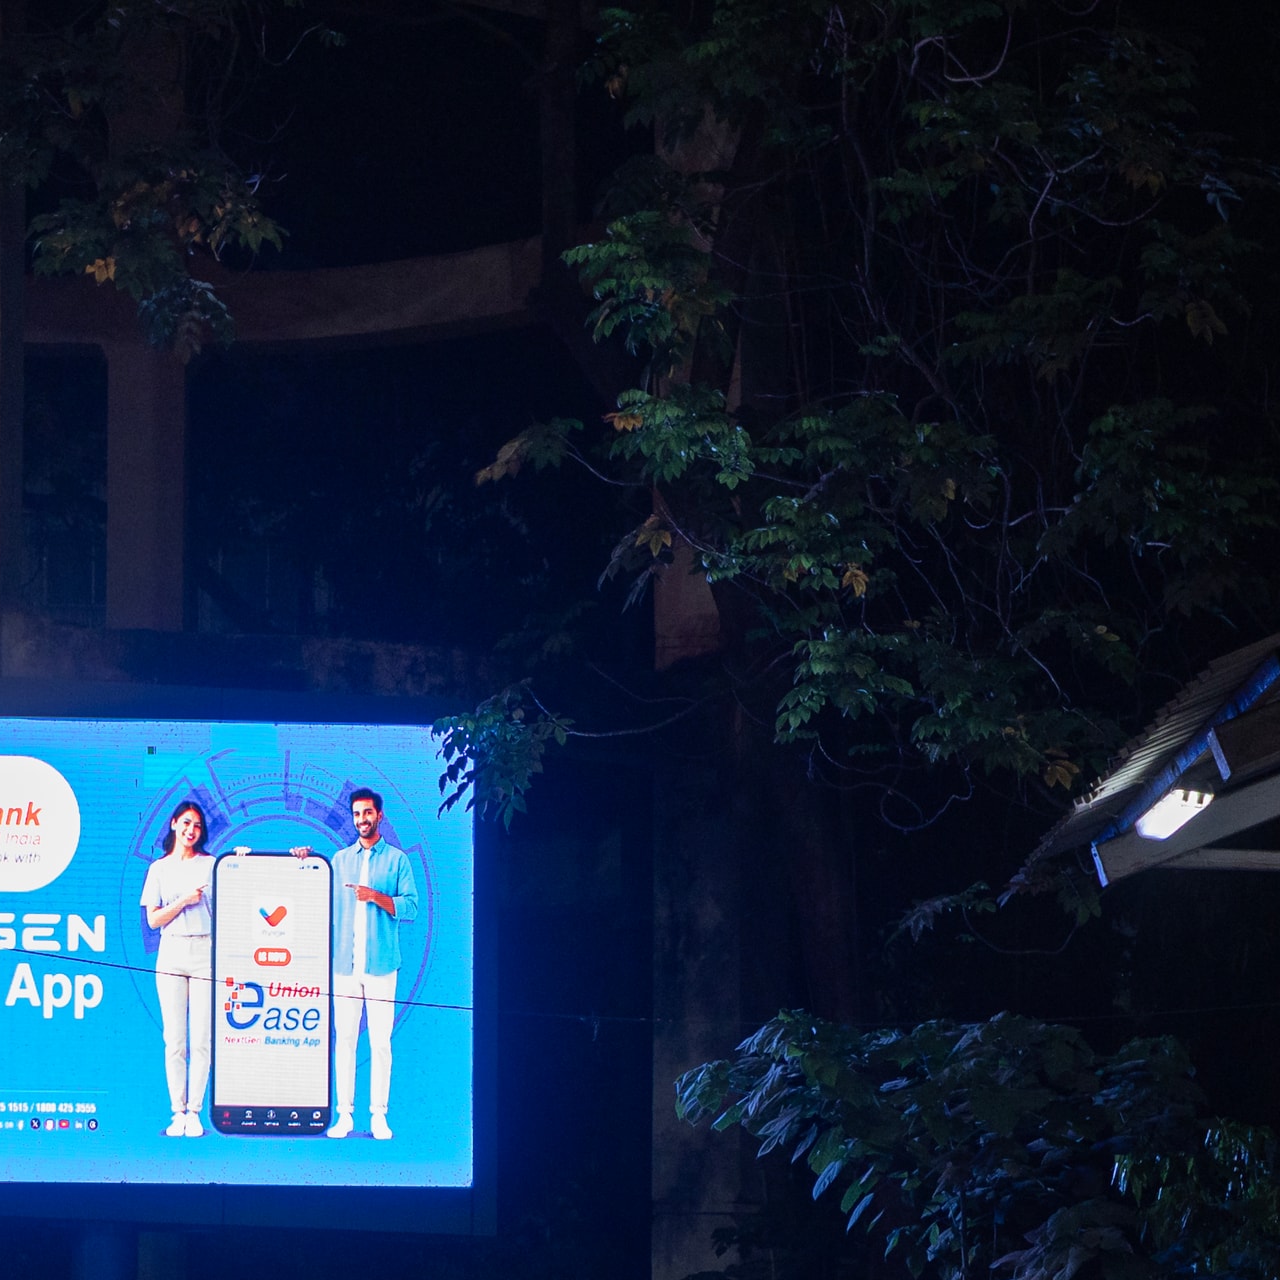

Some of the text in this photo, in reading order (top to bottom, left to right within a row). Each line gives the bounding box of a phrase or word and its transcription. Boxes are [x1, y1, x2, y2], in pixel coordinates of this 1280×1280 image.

[6, 832, 41, 846] India
[14, 851, 41, 863] with
[5, 962, 104, 1020] App
[268, 982, 320, 998] Union
[264, 1036, 301, 1048] Banking
[303, 1036, 321, 1047] App
